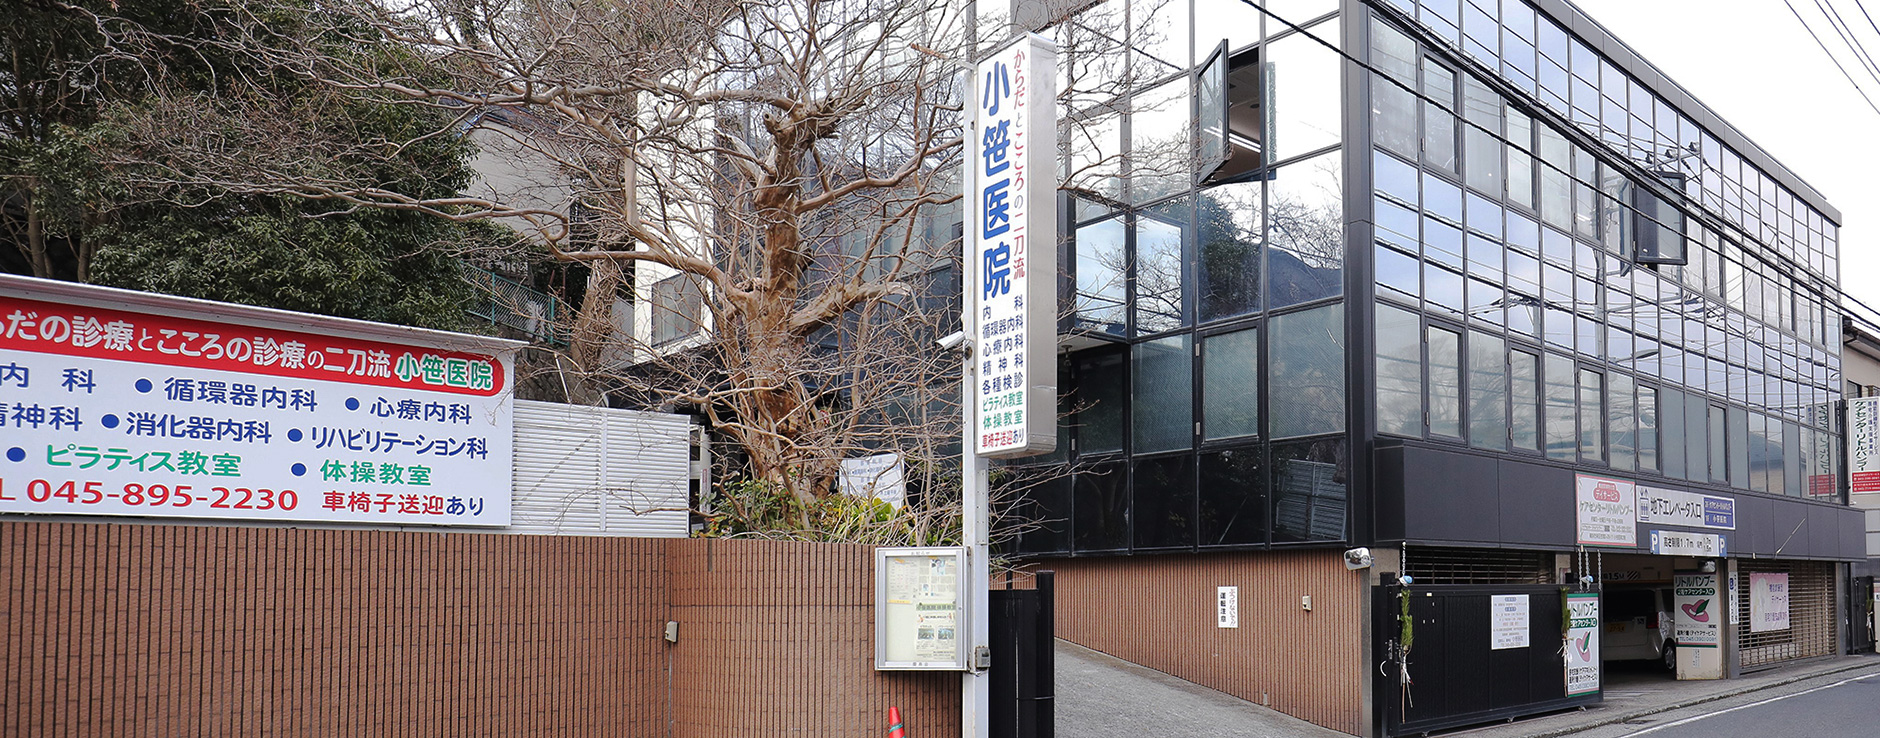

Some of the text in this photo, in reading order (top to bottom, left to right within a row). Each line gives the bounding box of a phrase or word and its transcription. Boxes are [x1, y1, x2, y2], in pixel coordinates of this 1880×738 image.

[983, 60, 1010, 301] 小笹医院
[1013, 49, 1026, 281] からだとこころの二刀流
[982, 313, 1024, 339] 循環器内科
[983, 333, 1024, 358] 心療内科
[395, 351, 494, 391] 小笹医院
[983, 352, 1024, 377] 精神科
[982, 372, 1024, 396] 各種検診
[164, 376, 318, 412] 循環器内科
[370, 396, 472, 425] 心療内科
[983, 391, 1024, 412] ピラティス教室
[126, 410, 273, 444] 消化器内科
[312, 427, 488, 460] リハビリテーション科
[983, 409, 1024, 431] 体操教室
[47, 443, 432, 487] ピラティス教室 体操教室
[26, 479, 298, 511] 045-895-2230
[322, 490, 484, 516] 車椅子送迎あり
[1650, 497, 1702, 519] 地下エレベータ入口
